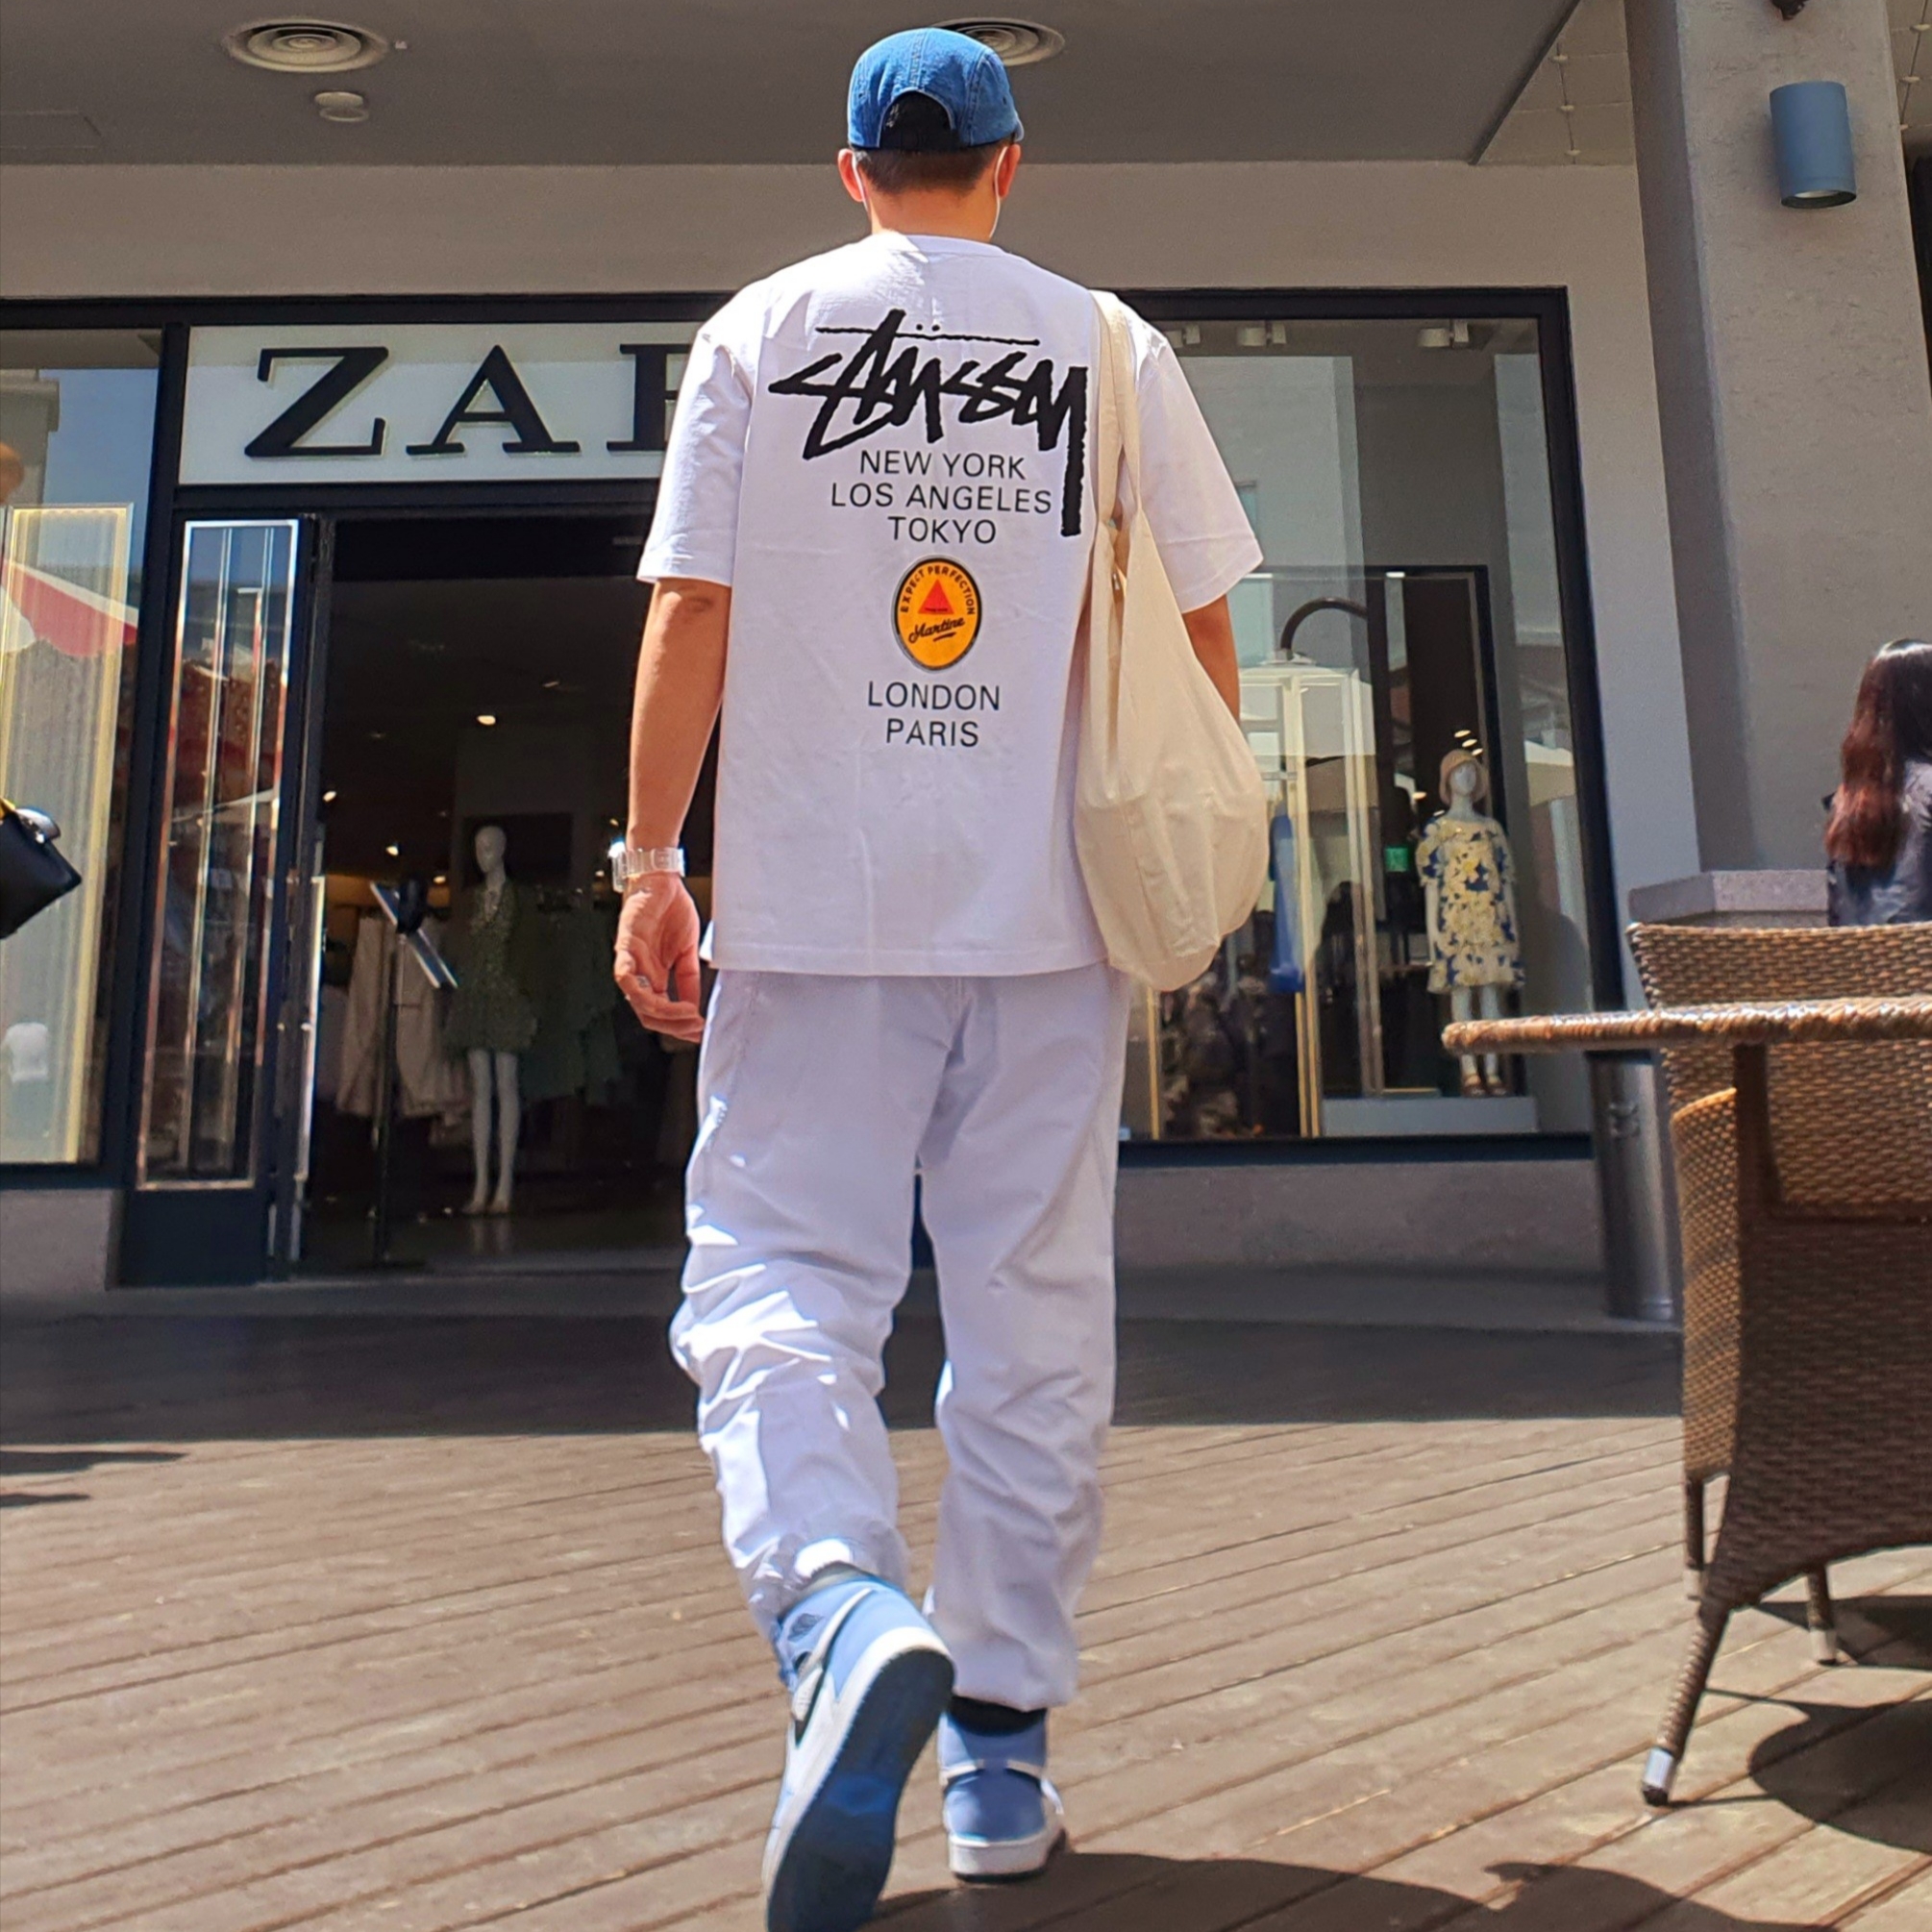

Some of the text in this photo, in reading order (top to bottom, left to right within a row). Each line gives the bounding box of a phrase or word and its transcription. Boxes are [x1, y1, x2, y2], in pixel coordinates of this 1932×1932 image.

[859, 450, 1026, 481] NEW YORK
[831, 482, 1052, 514] LOS ANGELES
[887, 515, 997, 545] TOKYO
[900, 565, 976, 615] EXPECT PERFECTION
[907, 617, 965, 644] Martine
[868, 681, 1000, 711] LONDON
[886, 717, 978, 748] PARIS
